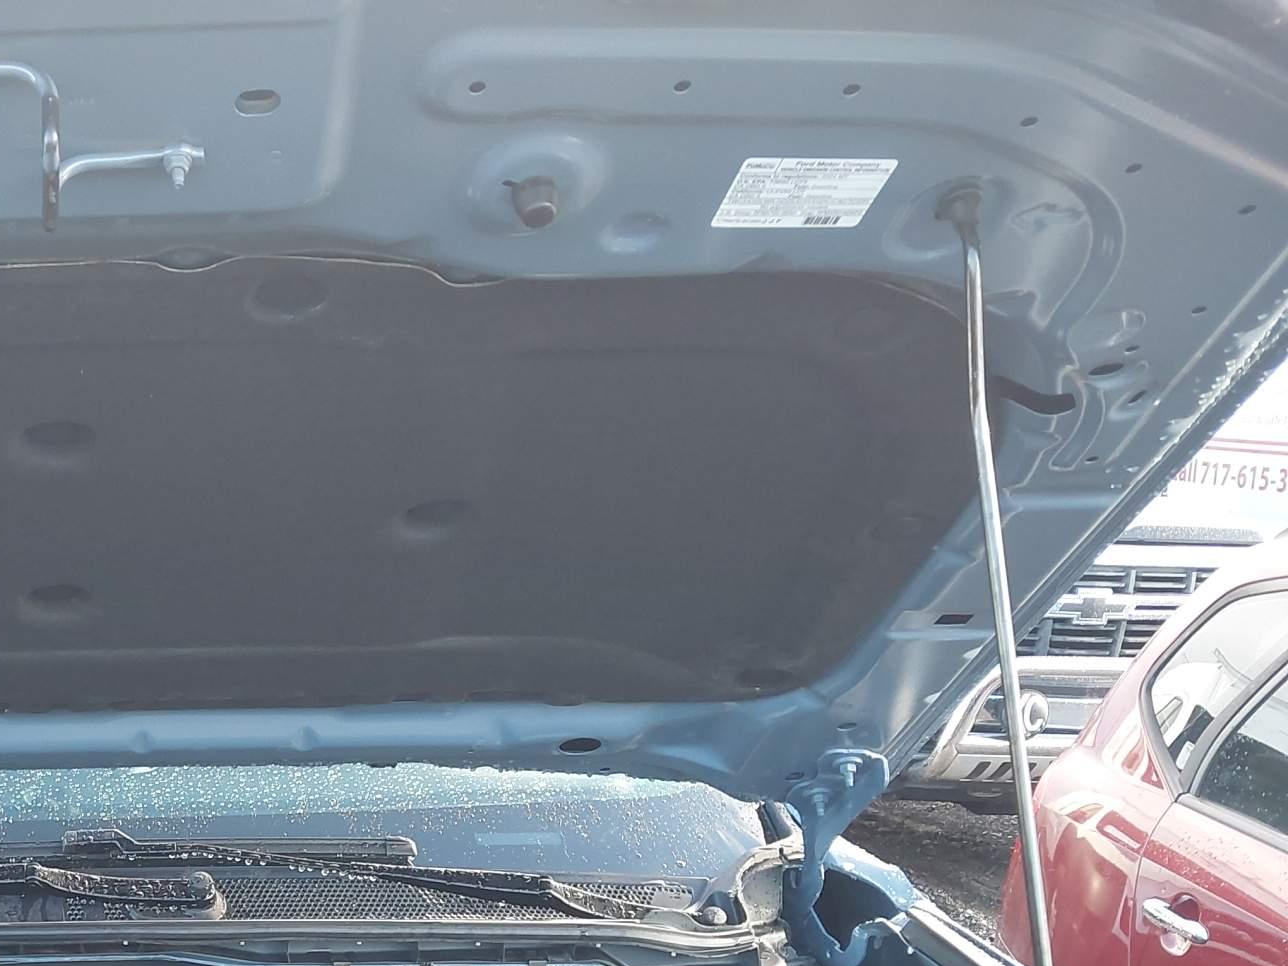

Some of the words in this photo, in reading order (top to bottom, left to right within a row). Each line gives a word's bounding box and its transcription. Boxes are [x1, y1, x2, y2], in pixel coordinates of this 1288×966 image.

[795, 160, 816, 168] Ford
[816, 160, 842, 168] Motor
[843, 161, 881, 169] Company
[1174, 459, 1198, 483] all
[1201, 461, 1288, 492] 717-615-3
